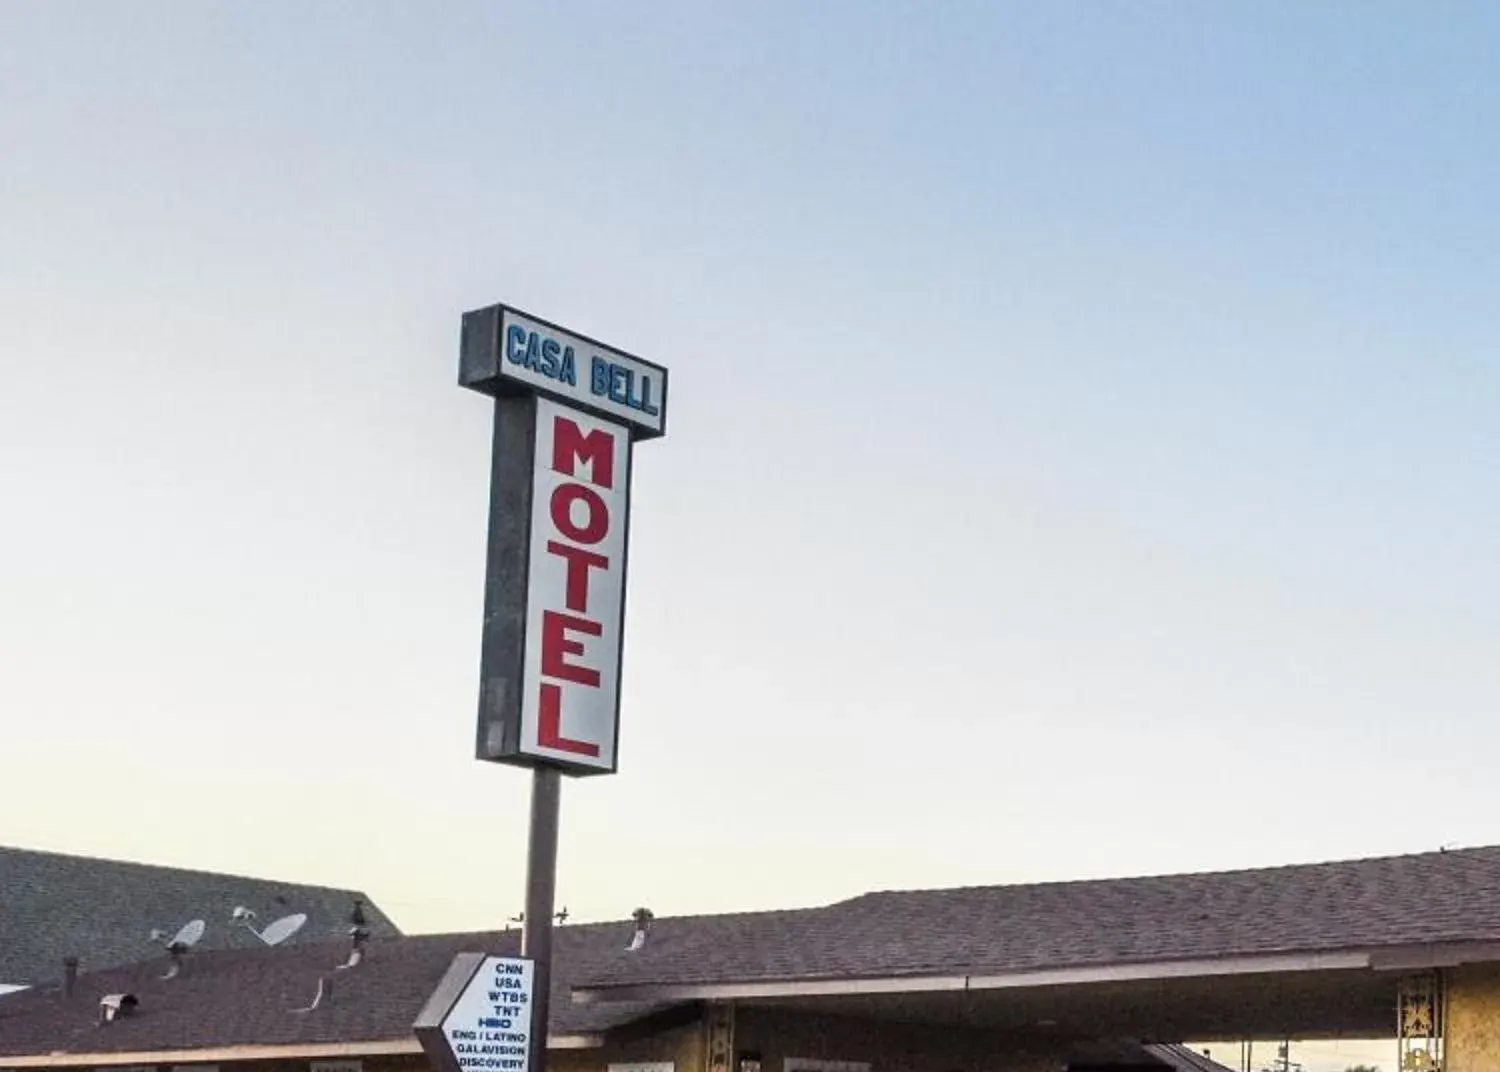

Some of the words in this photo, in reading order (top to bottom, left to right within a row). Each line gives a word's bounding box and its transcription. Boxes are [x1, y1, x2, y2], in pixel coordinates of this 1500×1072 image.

[506, 322, 577, 388] CASA
[590, 355, 659, 416] BELL
[537, 415, 614, 758] MOTEL
[495, 963, 523, 975] CNN
[495, 977, 522, 989] USA
[488, 991, 528, 1003] WTBS
[494, 1005, 521, 1017] TNT
[452, 1029, 477, 1040] ENG
[486, 1031, 527, 1042] LATINO
[457, 1044, 525, 1055] GALAVISION
[459, 1057, 524, 1069] DISCOVERY
